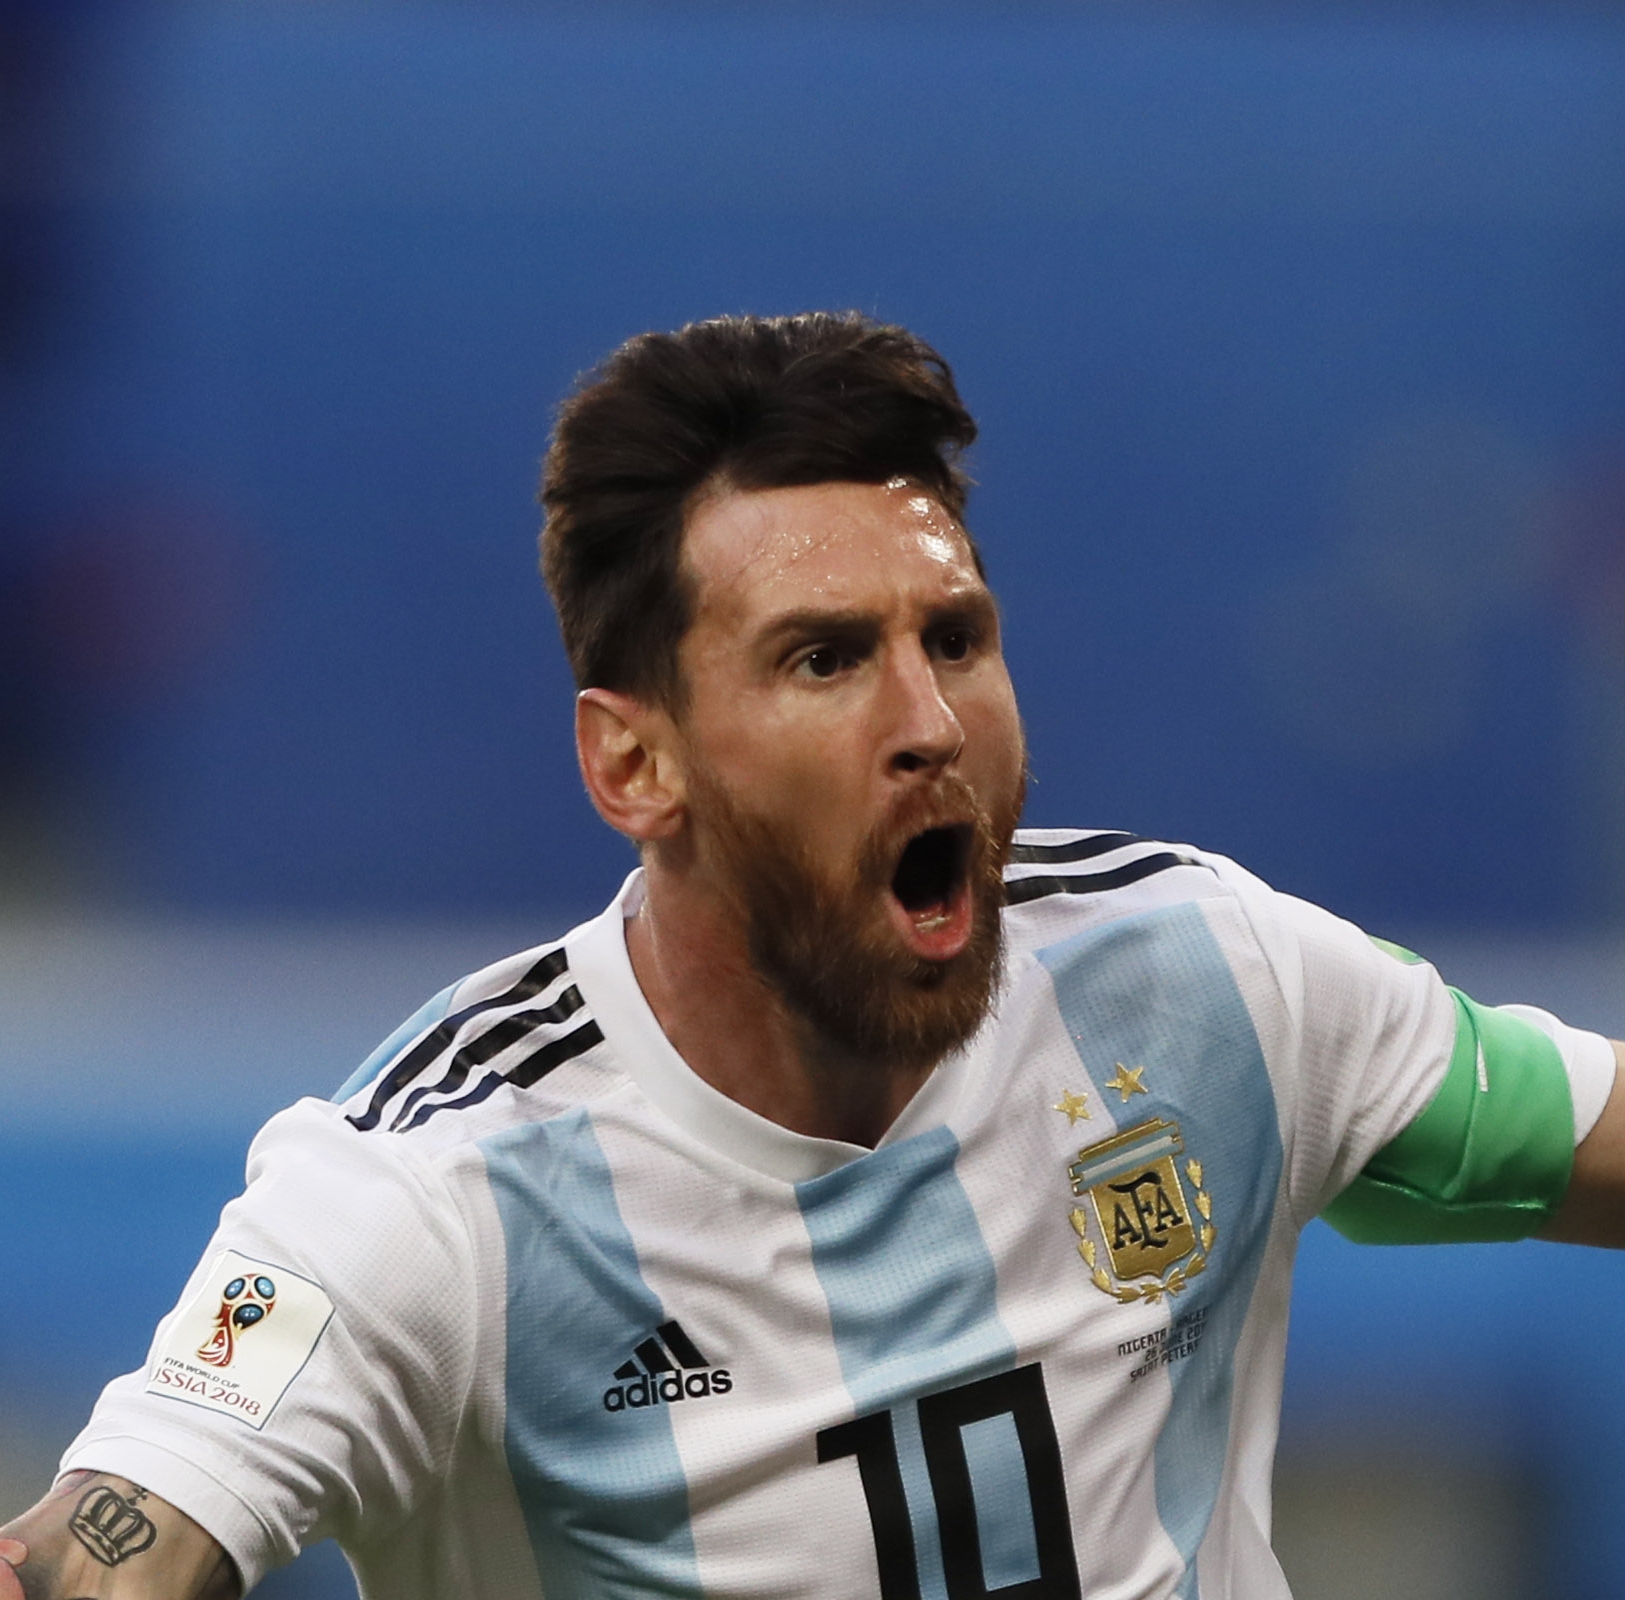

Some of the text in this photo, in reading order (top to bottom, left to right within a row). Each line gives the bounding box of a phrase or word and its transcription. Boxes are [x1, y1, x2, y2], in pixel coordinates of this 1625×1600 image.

[1108, 1171, 1184, 1250] AFA
[164, 1357, 241, 1389] FIFA WORLD CUP
[603, 1366, 733, 1413] adidas
[209, 1386, 261, 1416] 2018
